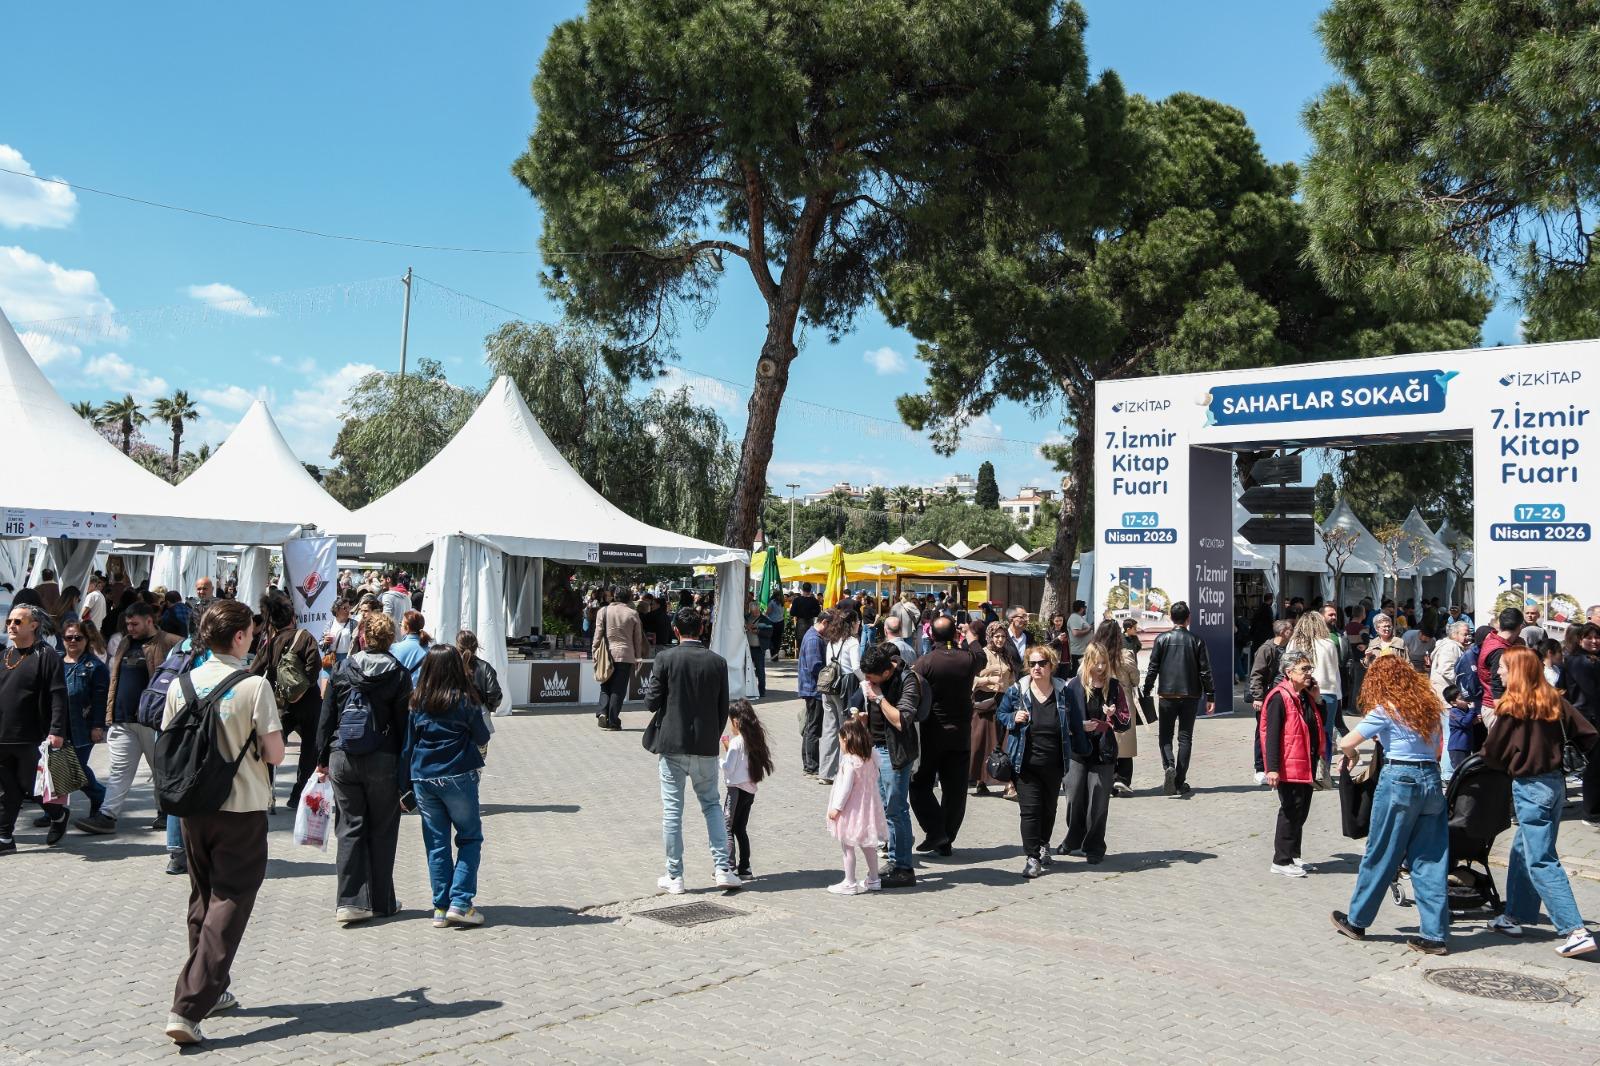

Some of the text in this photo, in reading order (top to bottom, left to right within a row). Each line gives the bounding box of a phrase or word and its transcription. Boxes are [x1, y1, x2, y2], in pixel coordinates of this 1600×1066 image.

[1517, 370, 1582, 386] İZKİTAP
[1222, 378, 1429, 415] SAHAFLAR SOKAĞI
[1124, 399, 1171, 413] İZKİTAP
[1491, 401, 1590, 430] 7. İzmir
[1105, 425, 1177, 449] 7. İzmir
[1501, 434, 1580, 460] Kitap
[1112, 453, 1169, 475] Kitap
[1502, 462, 1578, 484] Fuarı
[1113, 477, 1168, 495] Fuarı
[1124, 514, 1156, 526] 17-26
[1518, 507, 1561, 520] 17-26
[5, 522, 25, 534] H16
[1108, 530, 1174, 542] Nisan 2026
[1495, 526, 1586, 539] Nisan 2026
[587, 552, 598, 561] H17
[1195, 559, 1228, 582] 7. İzmir
[1199, 586, 1225, 607] Kitap
[1199, 608, 1225, 626] Fuarı
[540, 689, 571, 698] GUARDIAN
